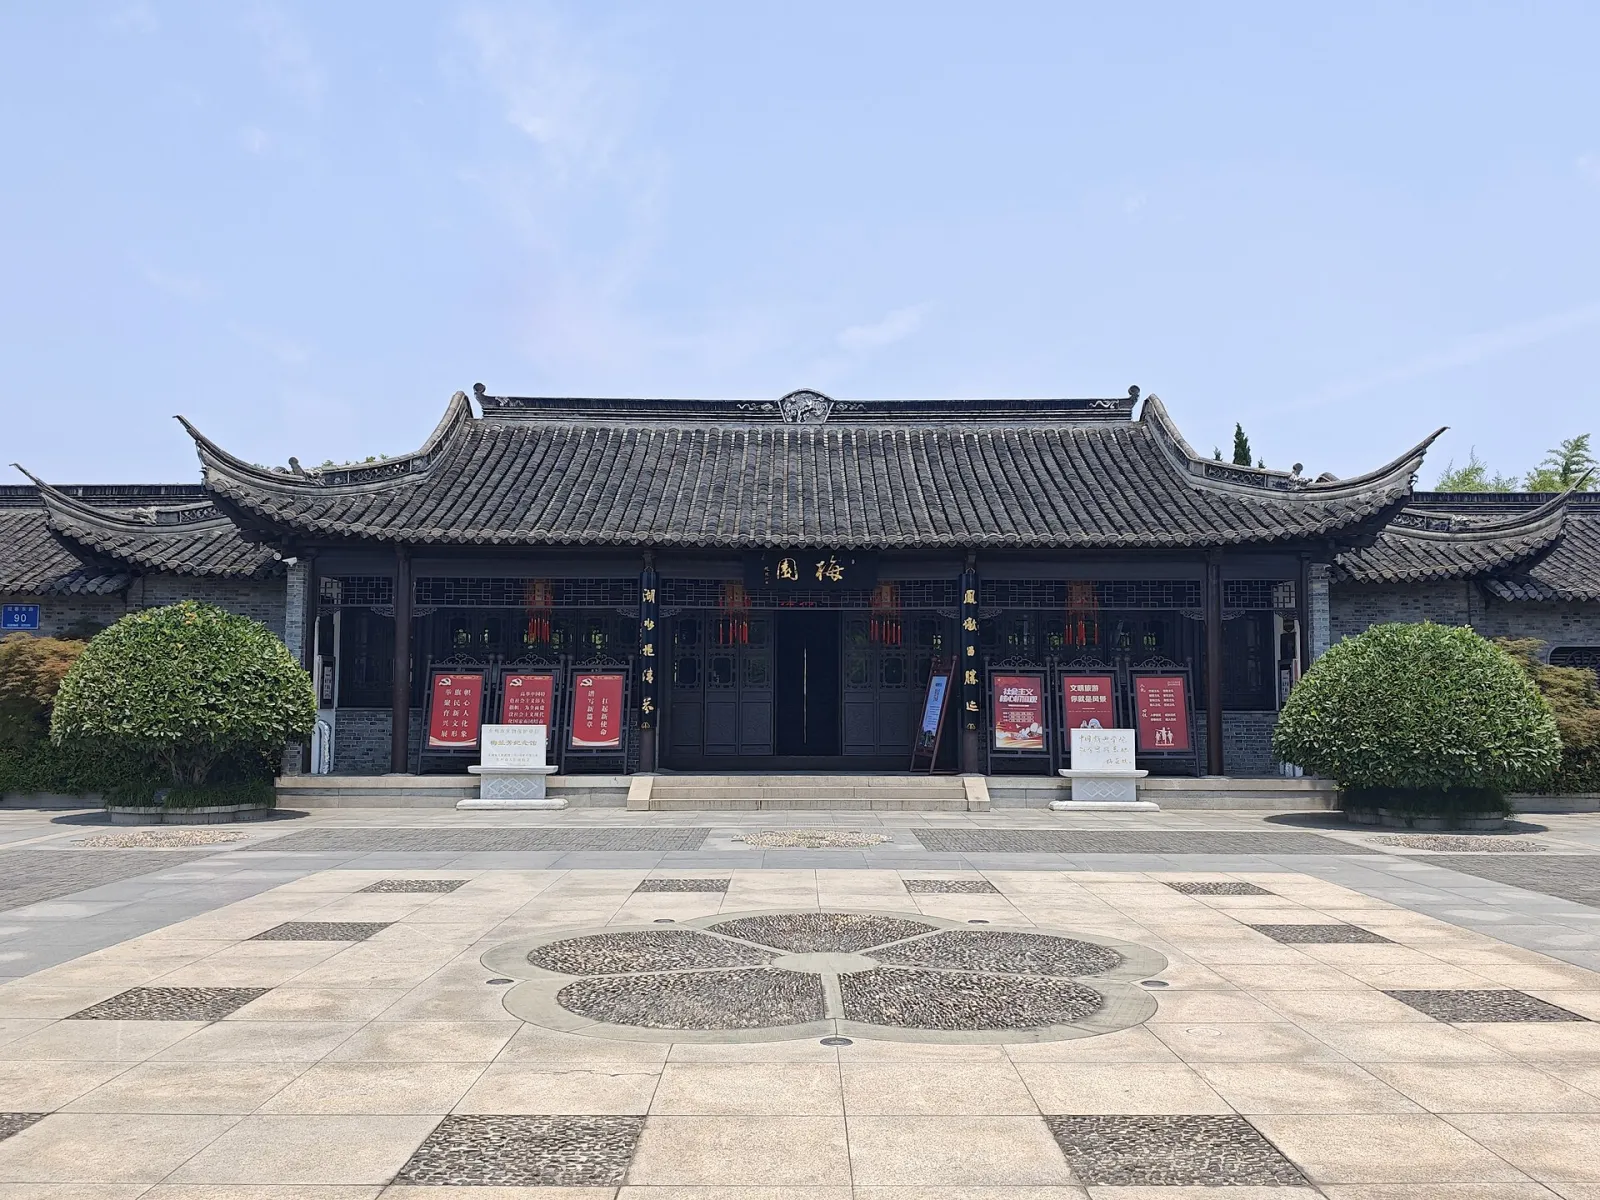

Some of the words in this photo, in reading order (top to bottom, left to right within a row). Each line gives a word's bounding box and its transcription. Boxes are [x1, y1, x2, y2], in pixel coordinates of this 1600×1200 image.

[14, 614, 27, 622] 90
[1003, 687, 1034, 696] 社会主义
[1069, 684, 1099, 692] 文明旅游
[443, 699, 471, 707] 聚民心
[999, 695, 1038, 704] 核心价值观
[443, 709, 469, 717] 育新人
[442, 719, 469, 727] 兴文化
[440, 730, 468, 738] 展形象
